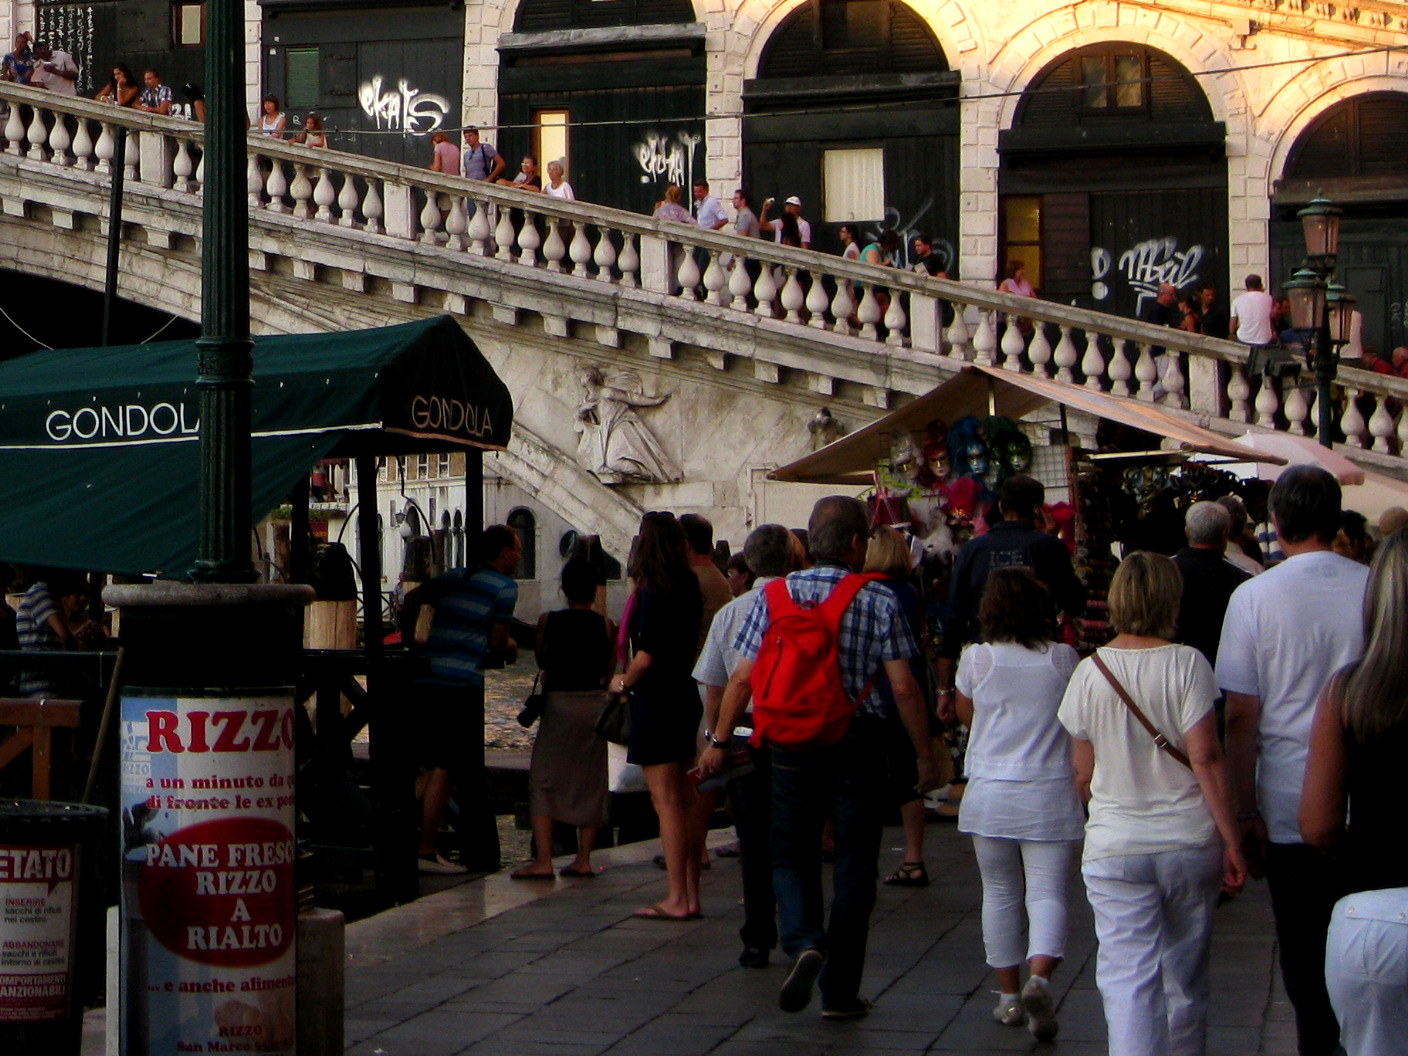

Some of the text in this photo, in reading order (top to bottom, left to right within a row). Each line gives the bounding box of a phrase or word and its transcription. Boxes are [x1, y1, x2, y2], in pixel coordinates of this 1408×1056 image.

[45, 402, 201, 441] GONDOL
[412, 395, 493, 437] GONDOLA
[146, 708, 295, 754] RIZZO
[146, 778, 154, 789] a
[161, 777, 184, 789] un
[192, 774, 263, 789] minuto
[269, 773, 284, 787] da
[146, 795, 162, 809] di
[166, 795, 230, 809] fronte
[236, 795, 251, 809] le
[256, 797, 273, 809] ex
[146, 843, 220, 868] PANE
[196, 869, 277, 895] RIZZO
[5, 898, 45, 906] INSERIRE
[5, 906, 32, 914] sacchi
[35, 906, 42, 914] di
[230, 897, 252, 922] A
[186, 922, 283, 950] RIALTO
[3, 939, 65, 949] ABBANDONARE
[2, 949, 29, 957] sacchi
[1, 957, 32, 966] intorno
[165, 981, 173, 992] e
[179, 979, 235, 993] anche
[219, 1024, 263, 1037] RIZZO
[177, 1041, 203, 1053] San
[207, 1041, 250, 1053] Marco
